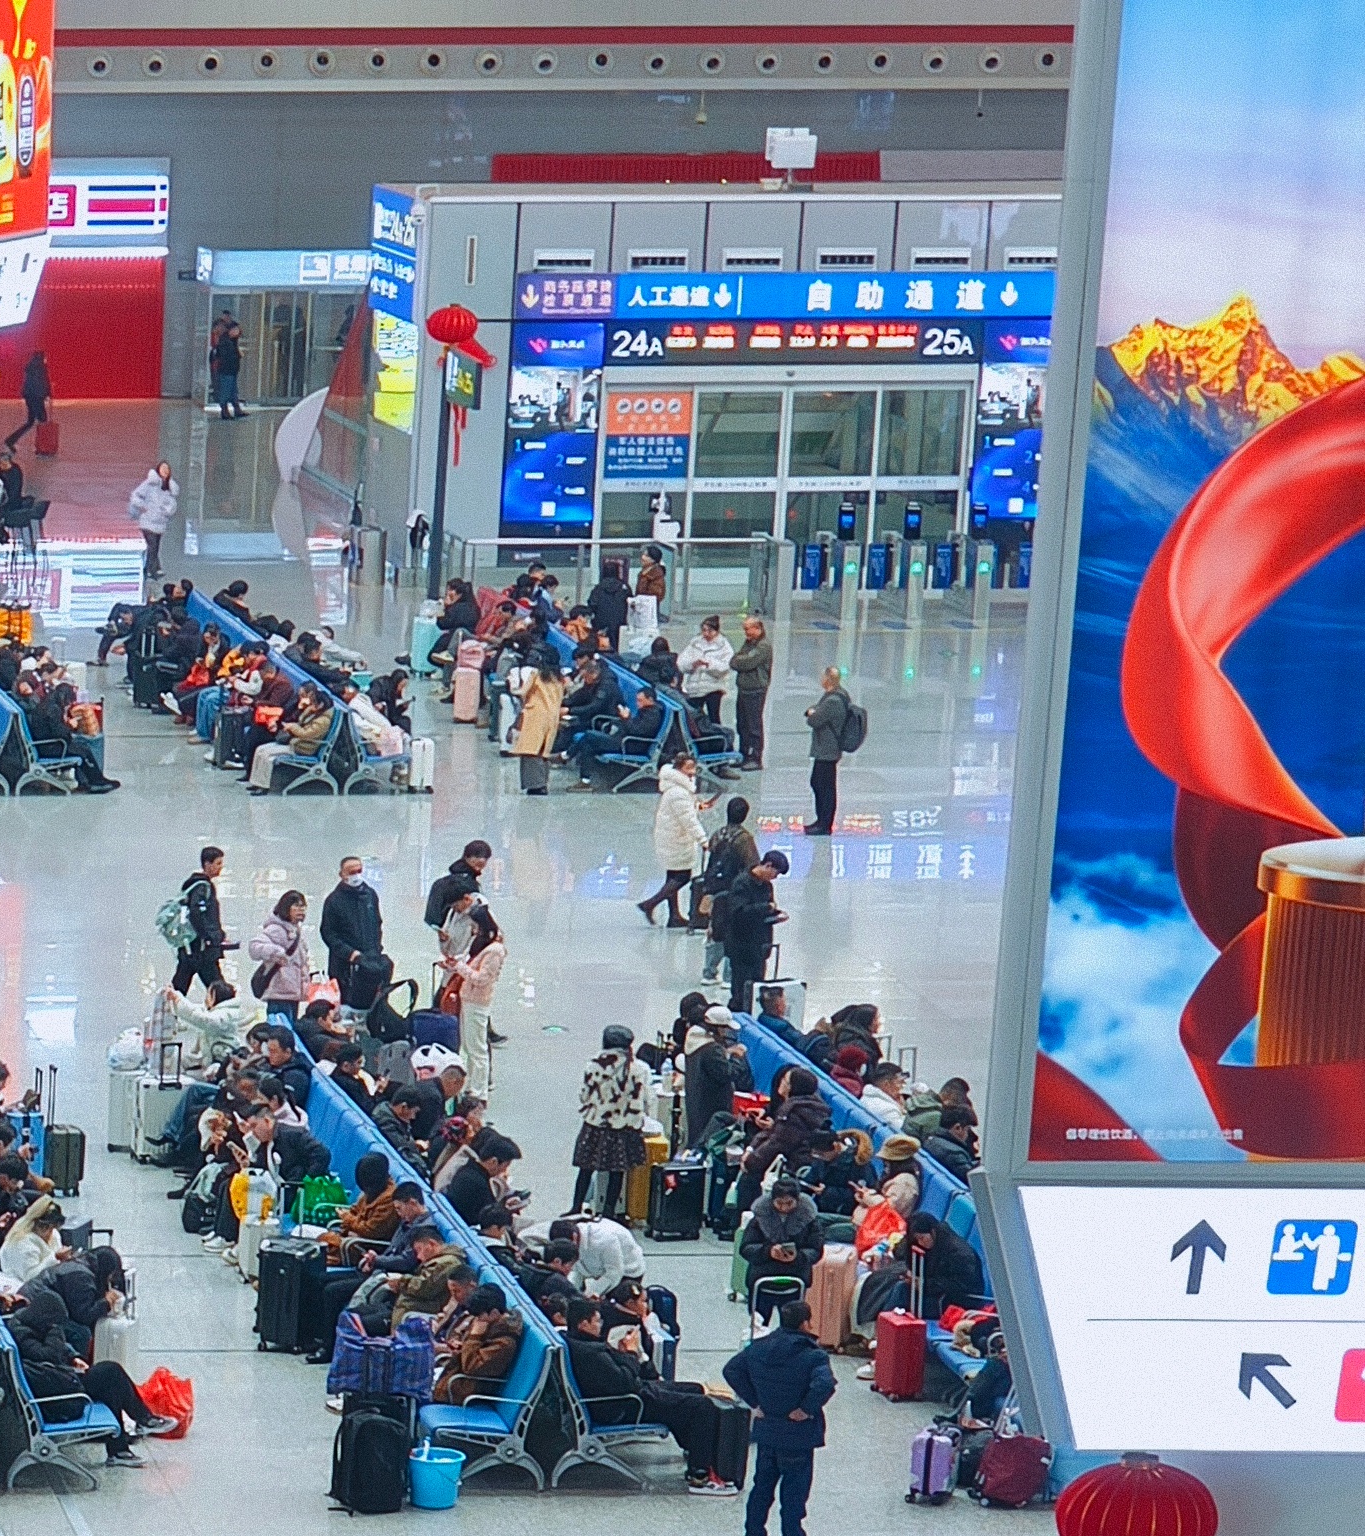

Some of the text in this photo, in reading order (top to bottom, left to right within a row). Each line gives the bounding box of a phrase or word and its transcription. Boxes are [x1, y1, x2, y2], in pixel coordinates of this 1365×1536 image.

[627, 285, 710, 308] 人工通道
[807, 279, 986, 311] 自助通道
[611, 329, 665, 357] 24A
[922, 328, 974, 356] 25A
